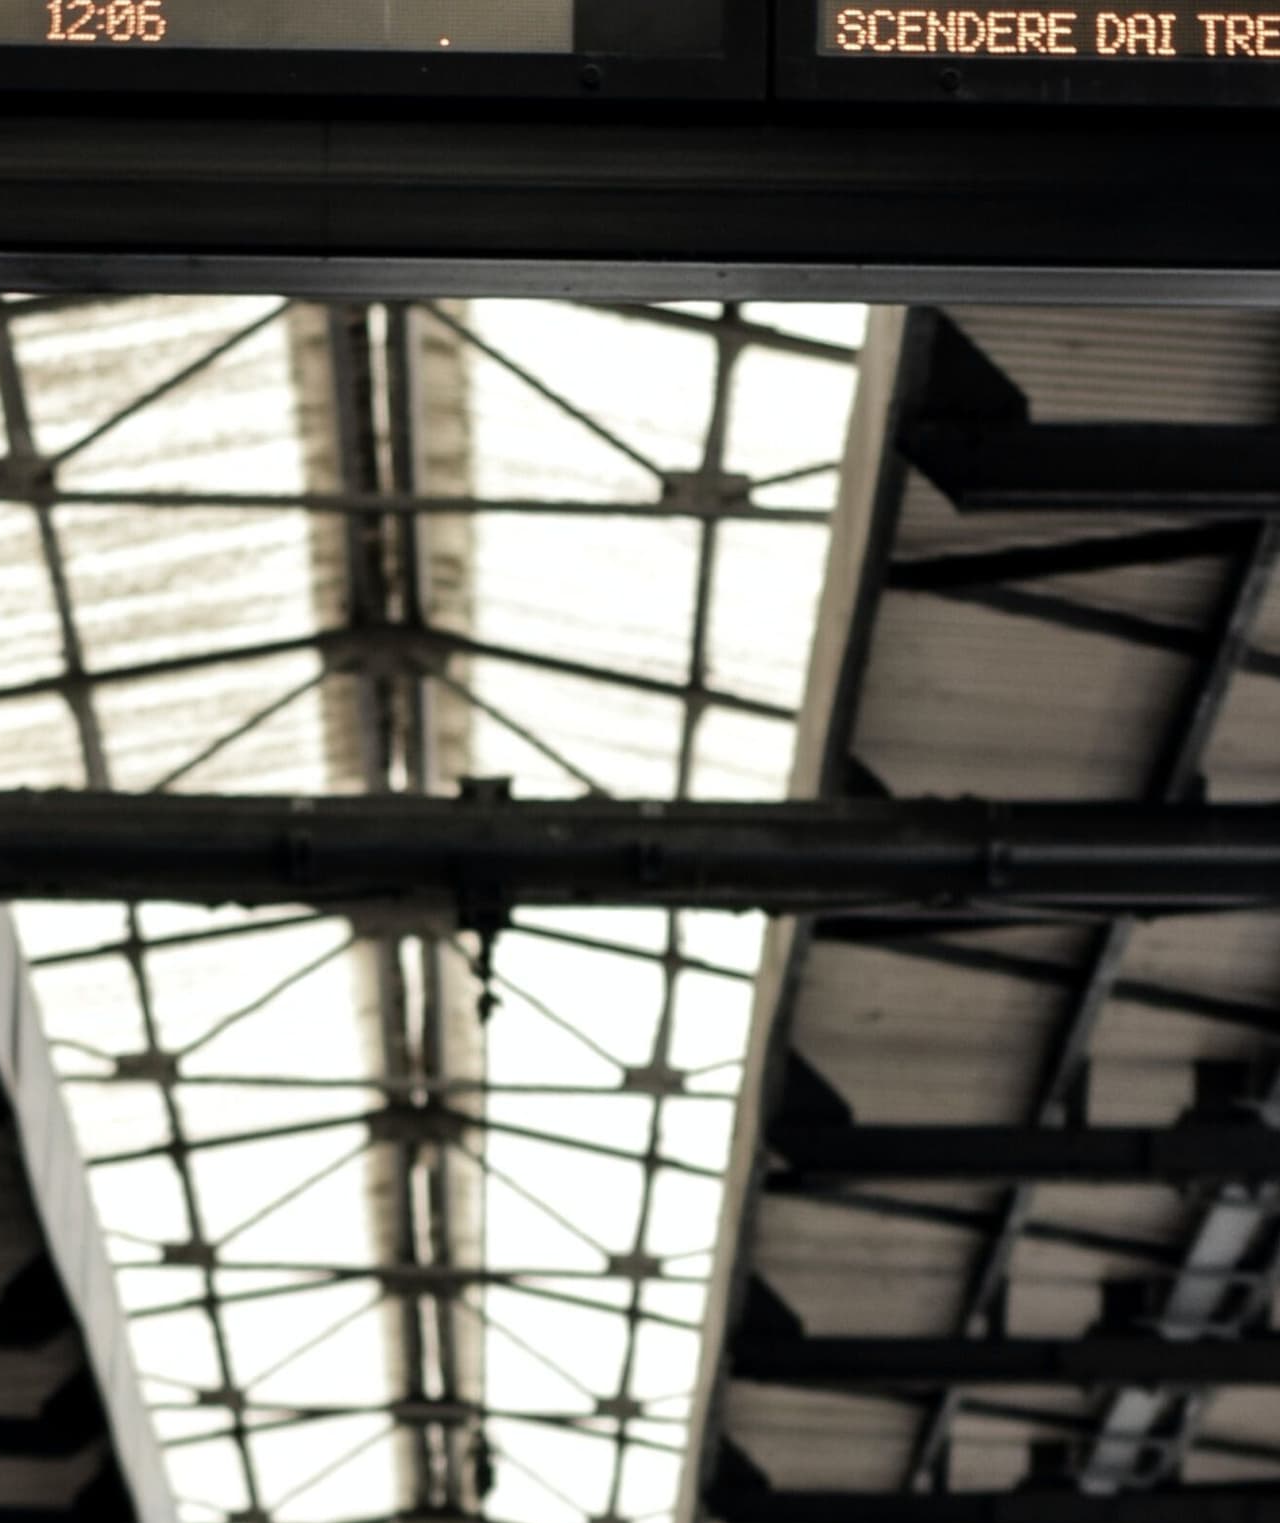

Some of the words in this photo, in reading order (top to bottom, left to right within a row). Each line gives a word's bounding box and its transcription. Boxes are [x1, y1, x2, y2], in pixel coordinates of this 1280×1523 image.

[46, 0, 167, 42] 12:06
[836, 8, 1078, 54] SCENDERE
[1095, 12, 1177, 56] DAI
